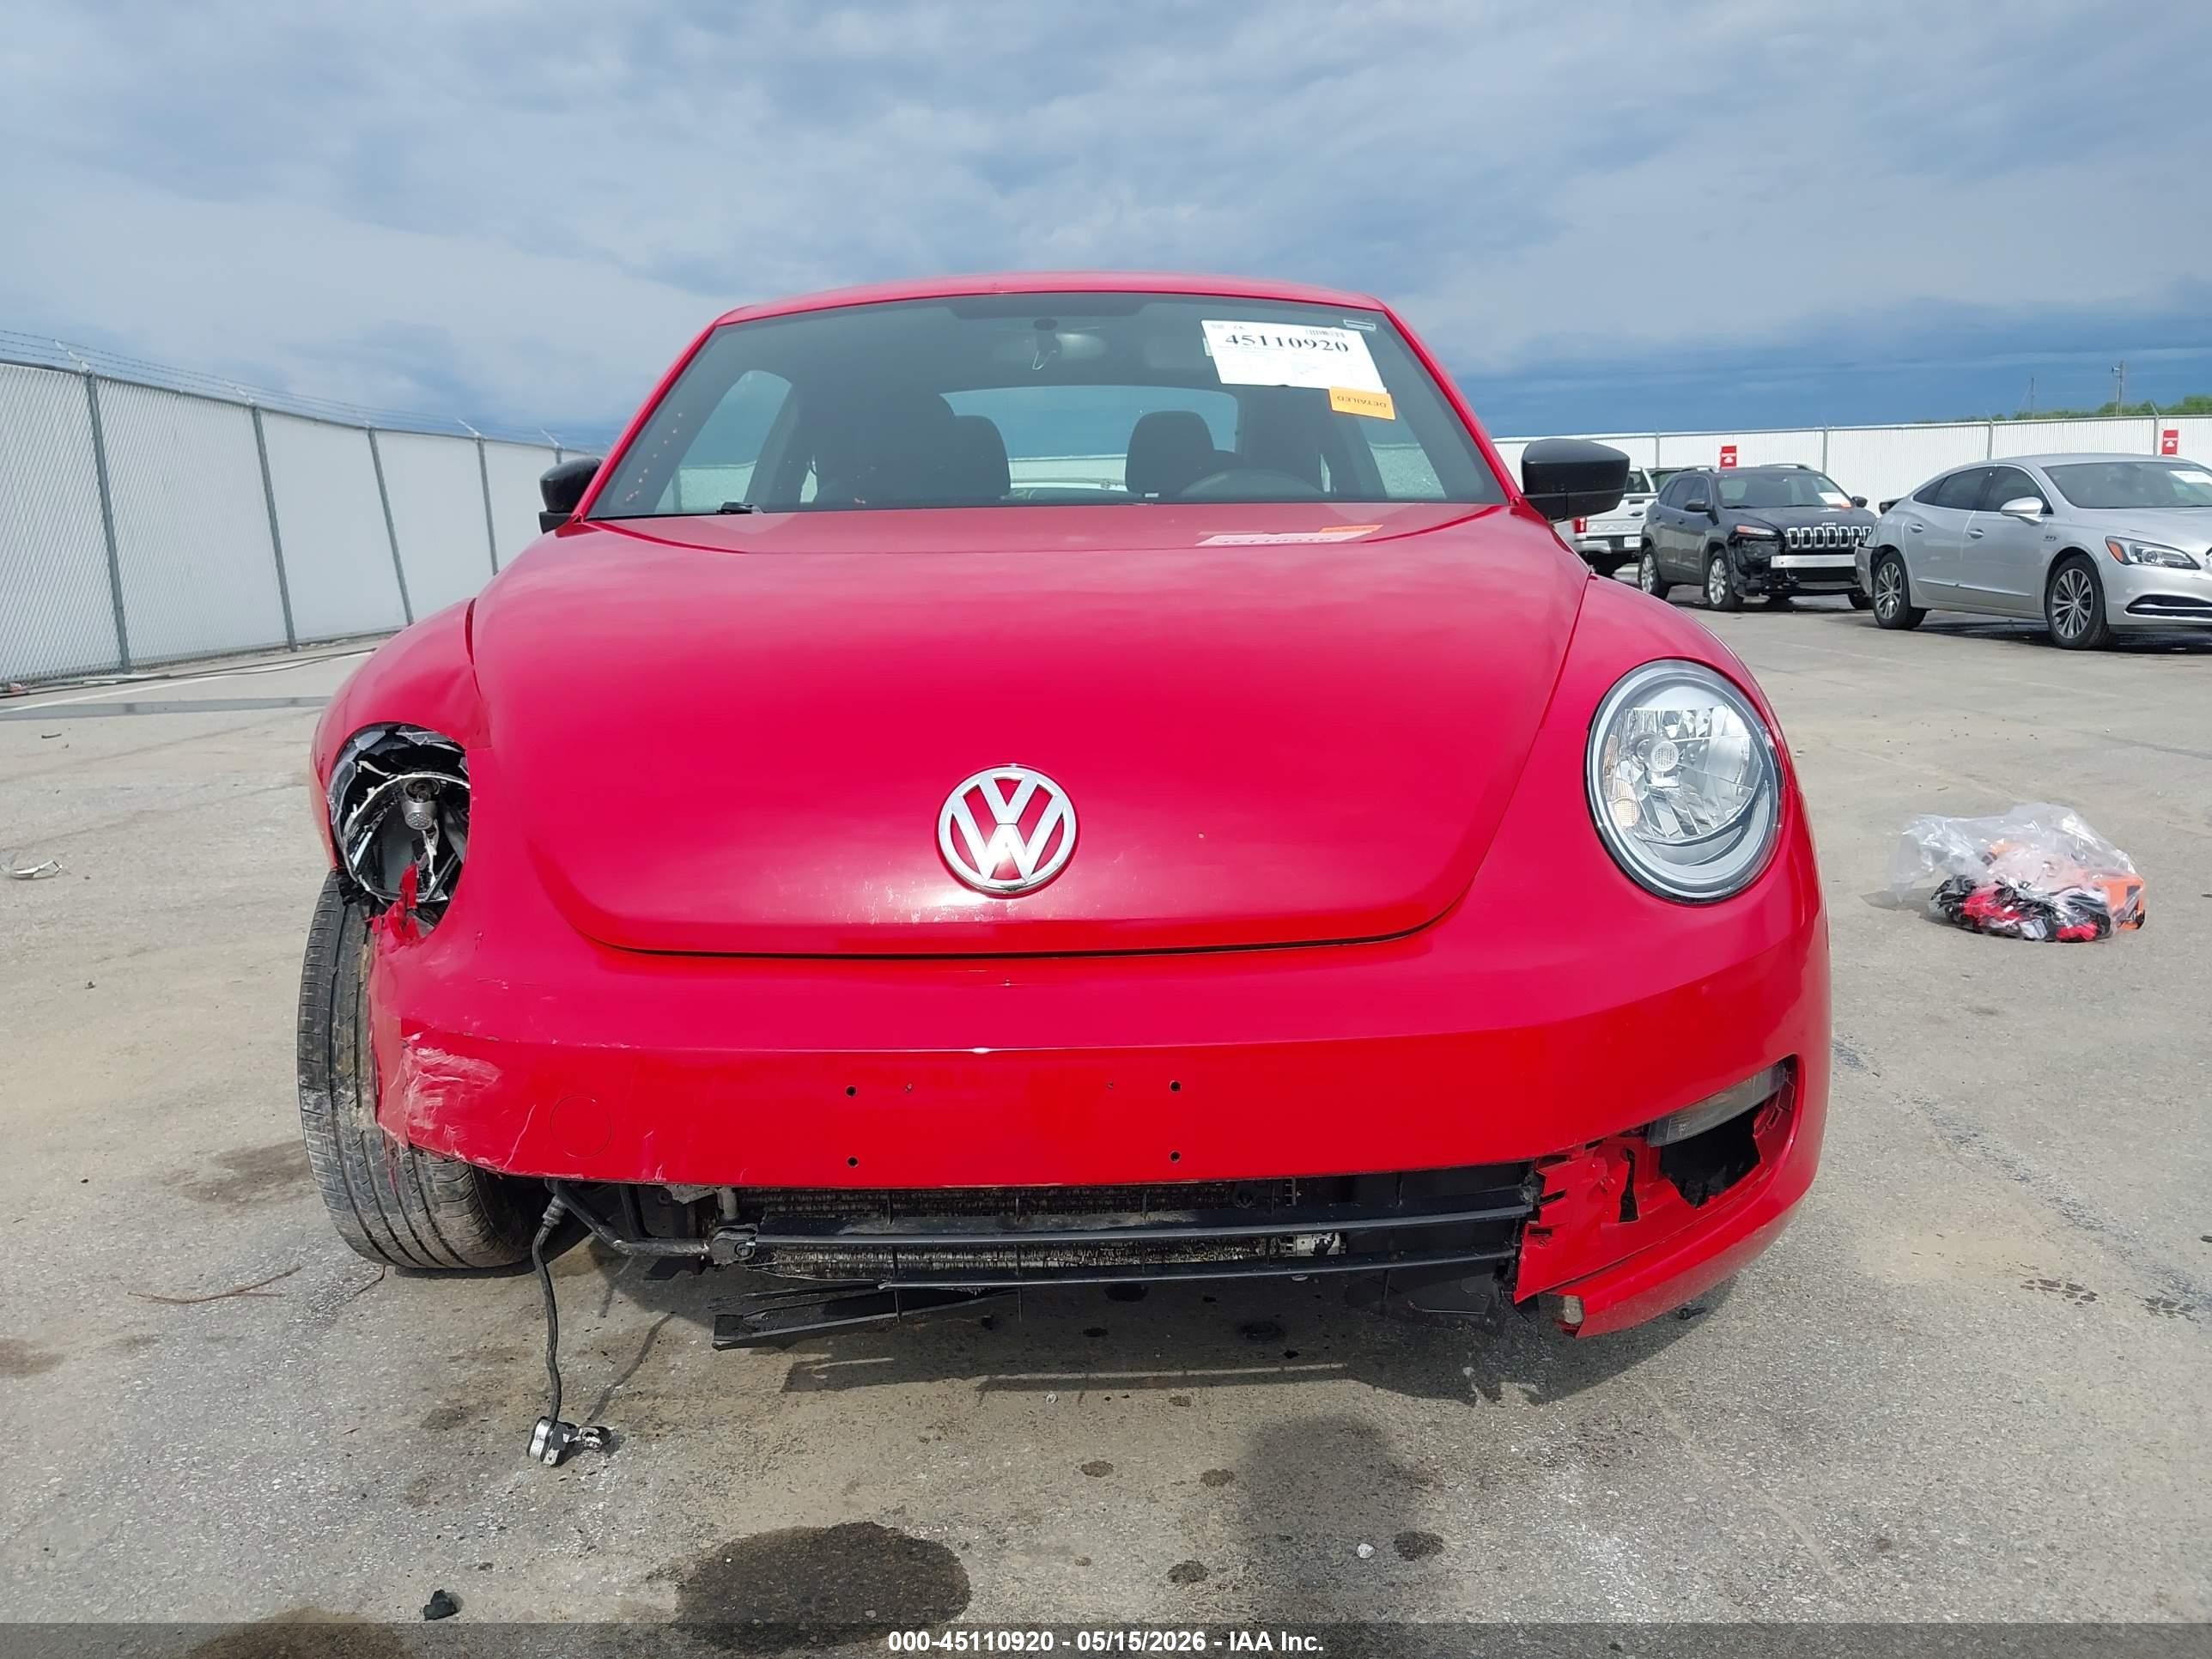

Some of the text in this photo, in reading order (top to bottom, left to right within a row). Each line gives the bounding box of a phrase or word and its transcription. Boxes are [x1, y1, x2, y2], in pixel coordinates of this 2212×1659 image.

[1225, 334, 1349, 353] 45110920
[1337, 395, 1387, 408] DETAILED
[940, 767, 1074, 889] VW
